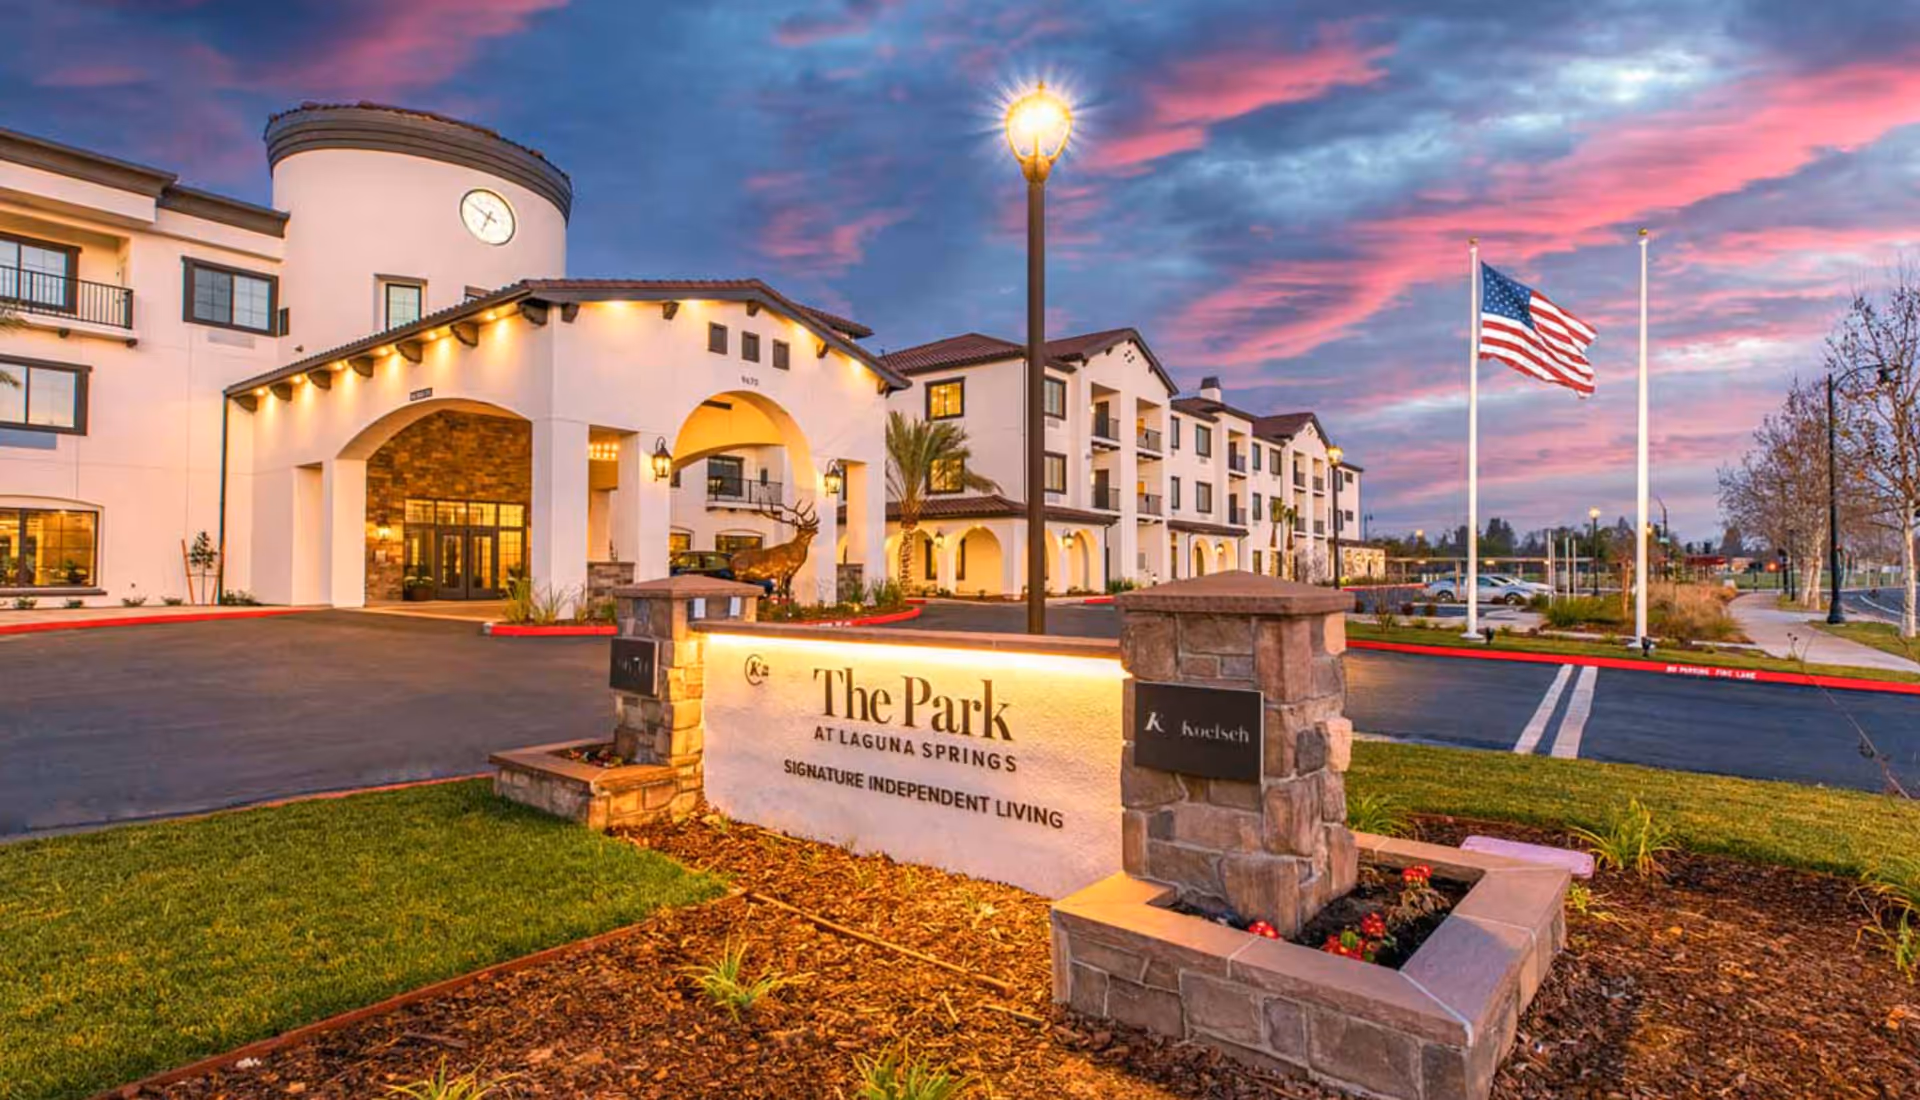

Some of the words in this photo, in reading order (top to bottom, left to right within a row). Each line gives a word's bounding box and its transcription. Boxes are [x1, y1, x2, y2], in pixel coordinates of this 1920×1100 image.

[813, 667, 892, 725] The
[901, 675, 1015, 741] Park
[1181, 720, 1250, 743] Koelsch
[814, 726, 834, 741] AT
[840, 728, 915, 755] LAGUNA
[922, 742, 1017, 772] SPRINGS
[784, 759, 864, 789] SIGNATURE
[869, 775, 990, 813] INDEPENDENT
[996, 800, 1064, 829] LIVING
